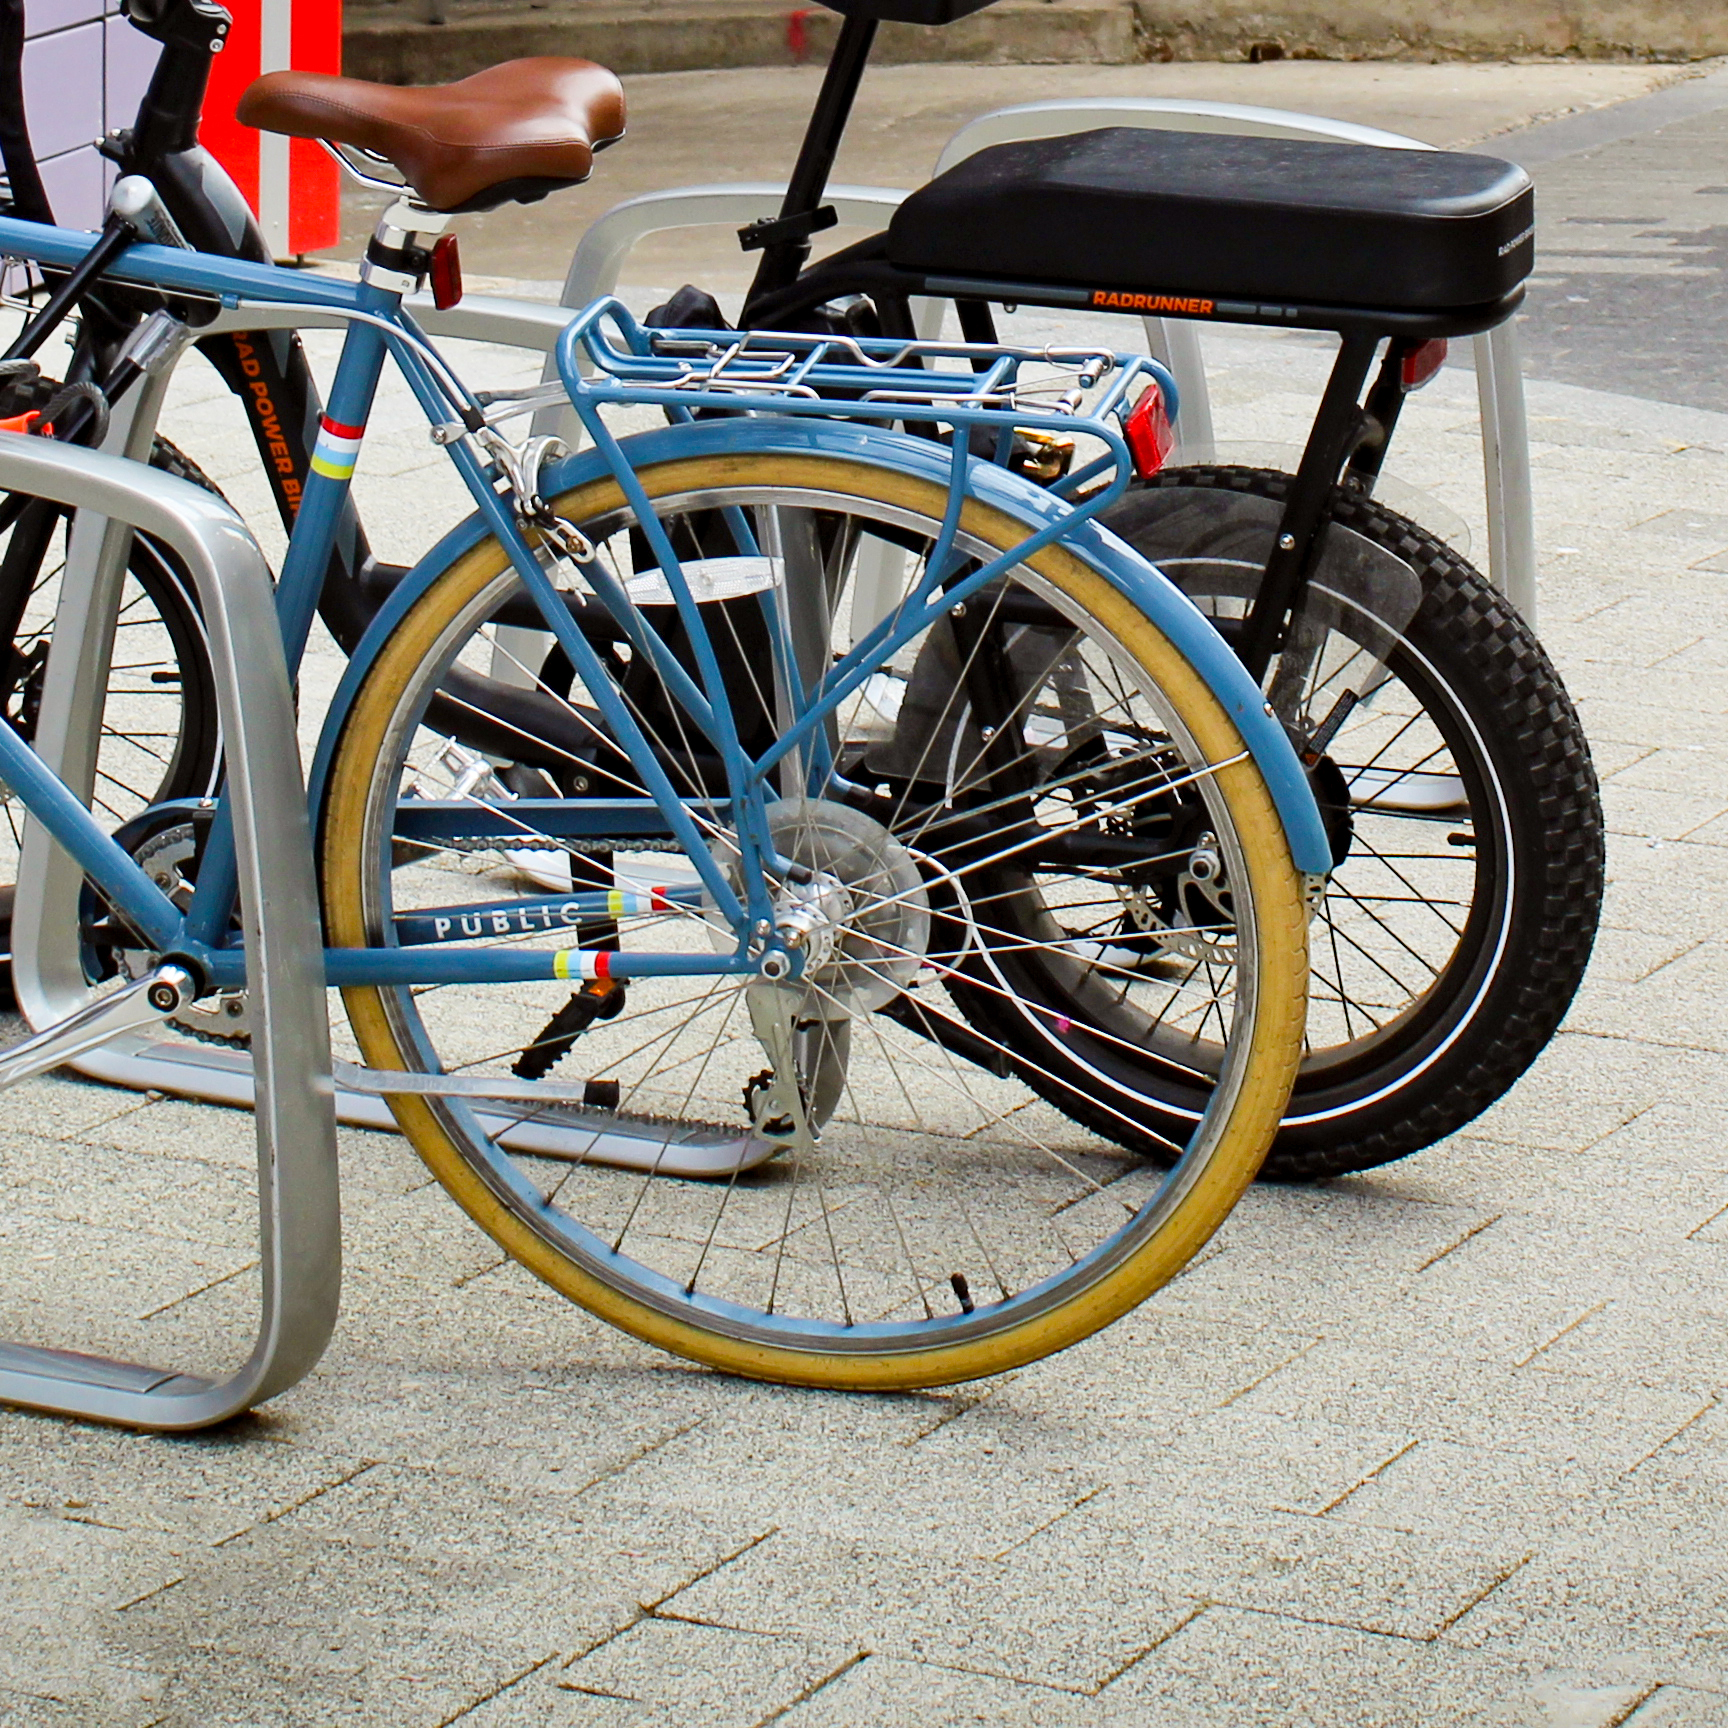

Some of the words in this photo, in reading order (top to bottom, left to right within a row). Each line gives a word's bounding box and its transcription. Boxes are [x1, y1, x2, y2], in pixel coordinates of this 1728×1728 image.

[1092, 290, 1214, 314] RADRUNNER
[249, 382, 293, 473] POWER
[434, 901, 583, 939] PUBLIC
